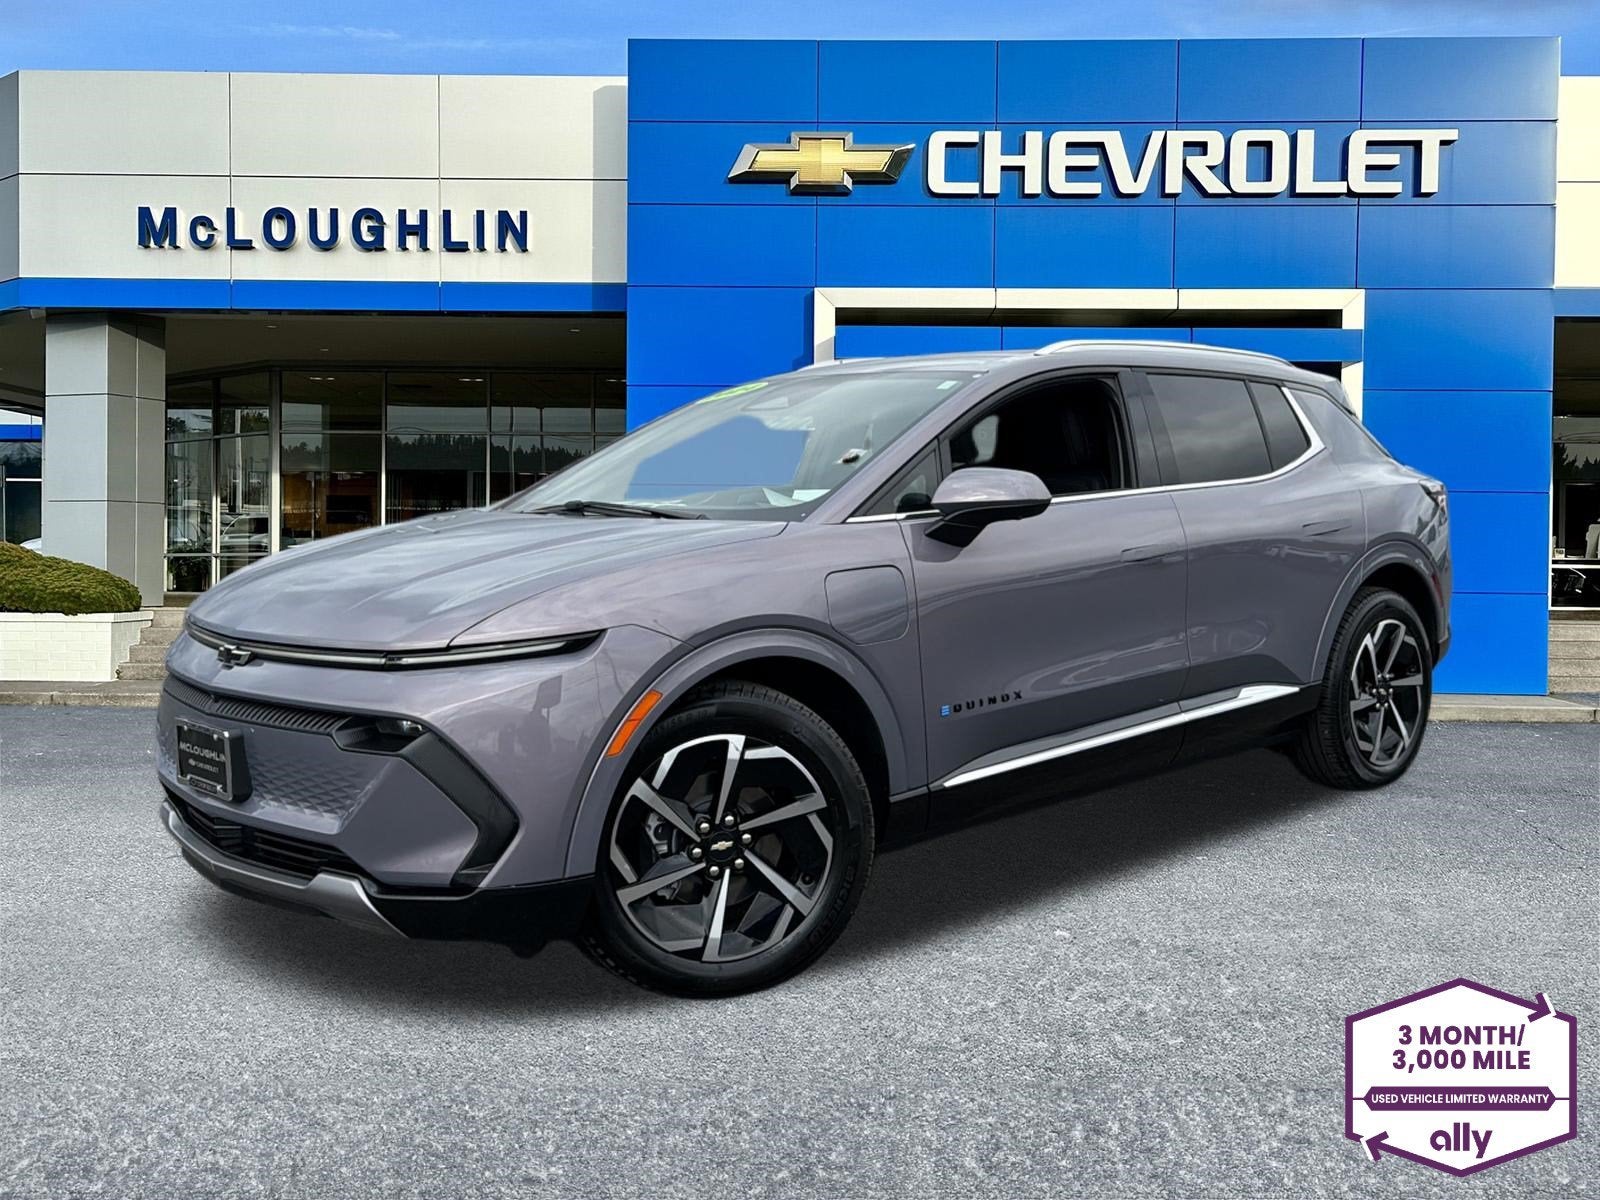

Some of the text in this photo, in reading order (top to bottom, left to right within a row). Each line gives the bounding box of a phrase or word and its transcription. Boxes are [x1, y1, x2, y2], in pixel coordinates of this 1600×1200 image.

[927, 129, 1459, 196] CHEVROLET
[137, 206, 530, 253] McLOUGHLIN
[940, 690, 1022, 716] EQUINOX
